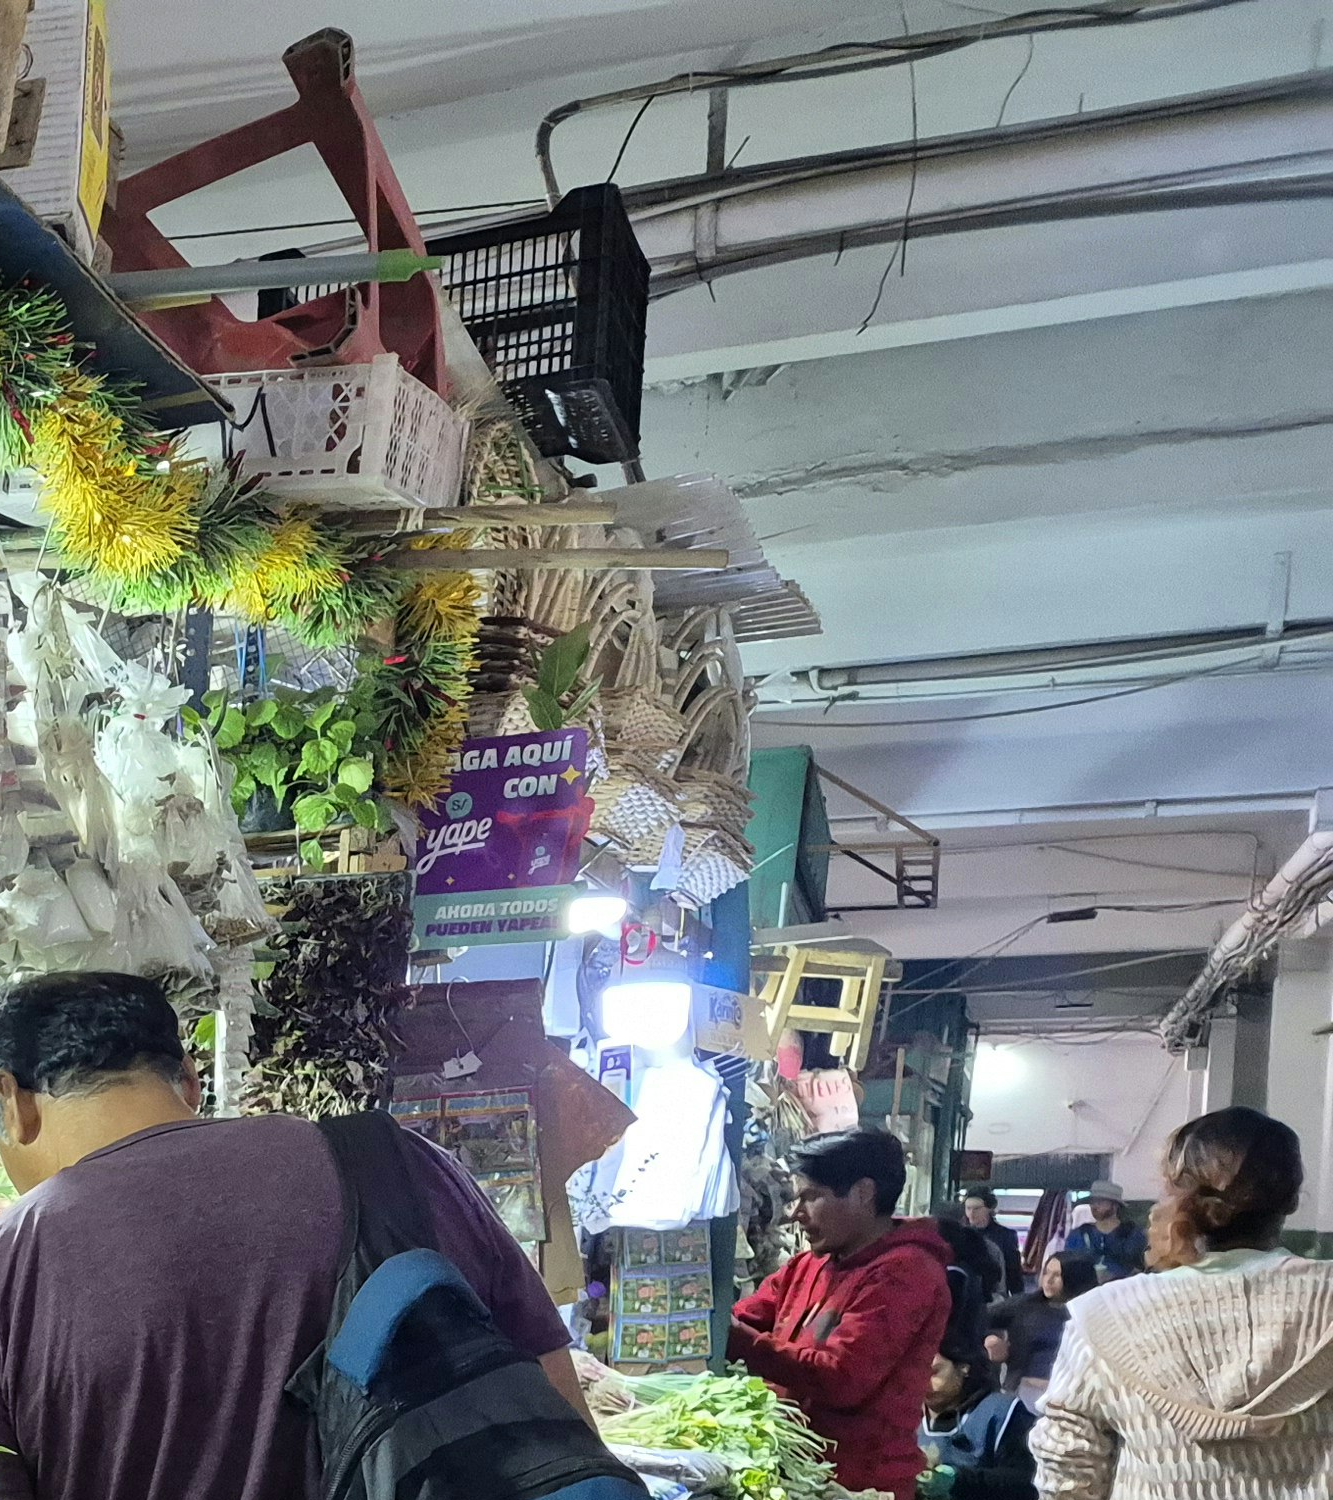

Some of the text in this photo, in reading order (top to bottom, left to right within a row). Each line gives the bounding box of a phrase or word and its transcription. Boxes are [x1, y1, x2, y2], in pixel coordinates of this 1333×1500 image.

[503, 734, 574, 768] AQUÍ
[503, 774, 558, 799] CON
[416, 817, 493, 875] yape
[435, 898, 559, 921] AHORA TODOS
[425, 919, 493, 938] PUEDEN
